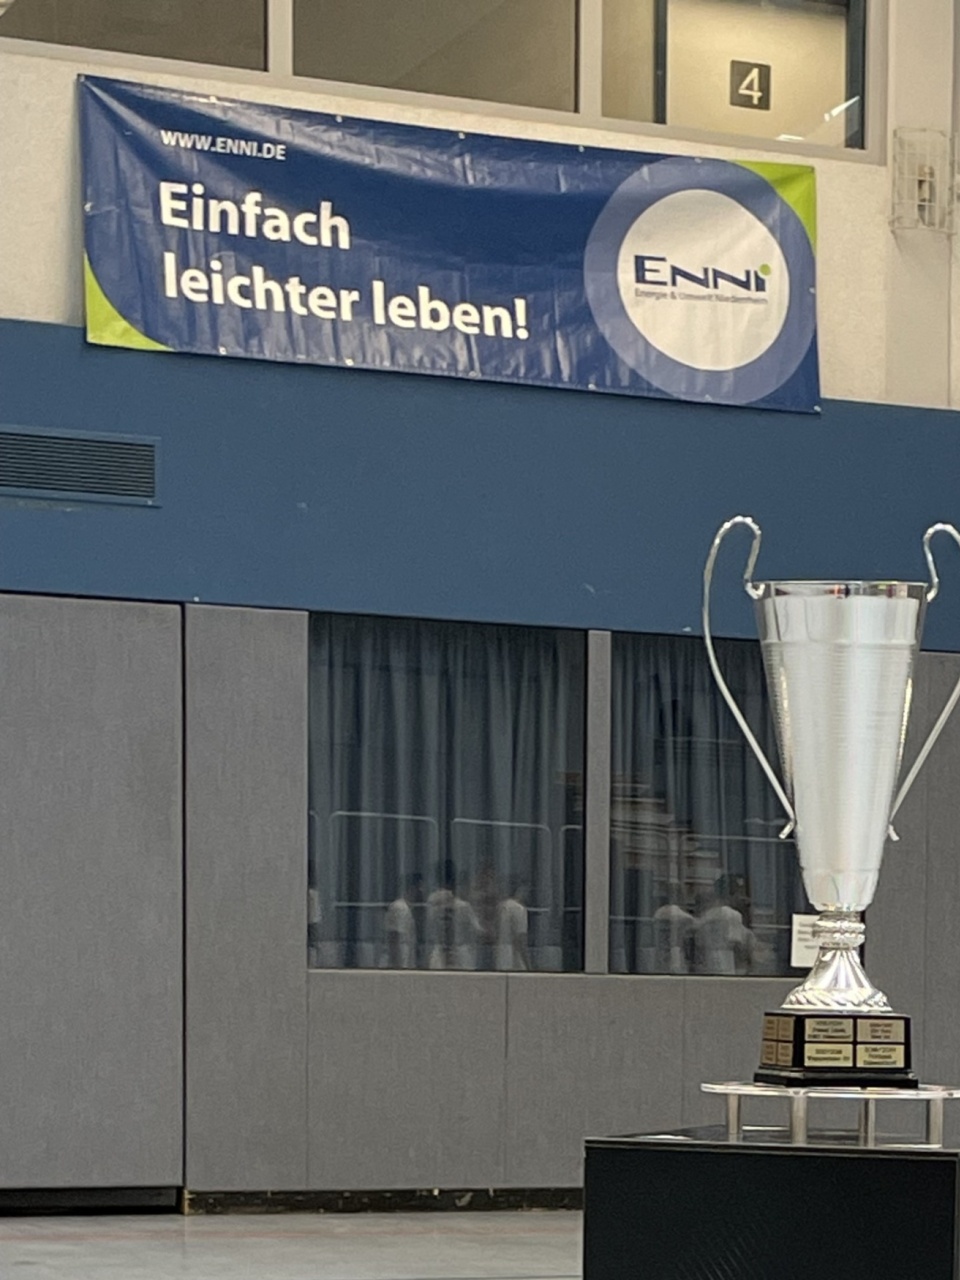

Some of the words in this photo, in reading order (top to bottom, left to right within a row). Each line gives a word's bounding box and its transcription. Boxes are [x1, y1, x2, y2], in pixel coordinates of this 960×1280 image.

[738, 67, 763, 105] 4
[160, 129, 287, 161] WWW.ENNI.DE
[160, 181, 352, 249] Einfach
[164, 252, 360, 321] leichter
[371, 280, 529, 339] leben!
